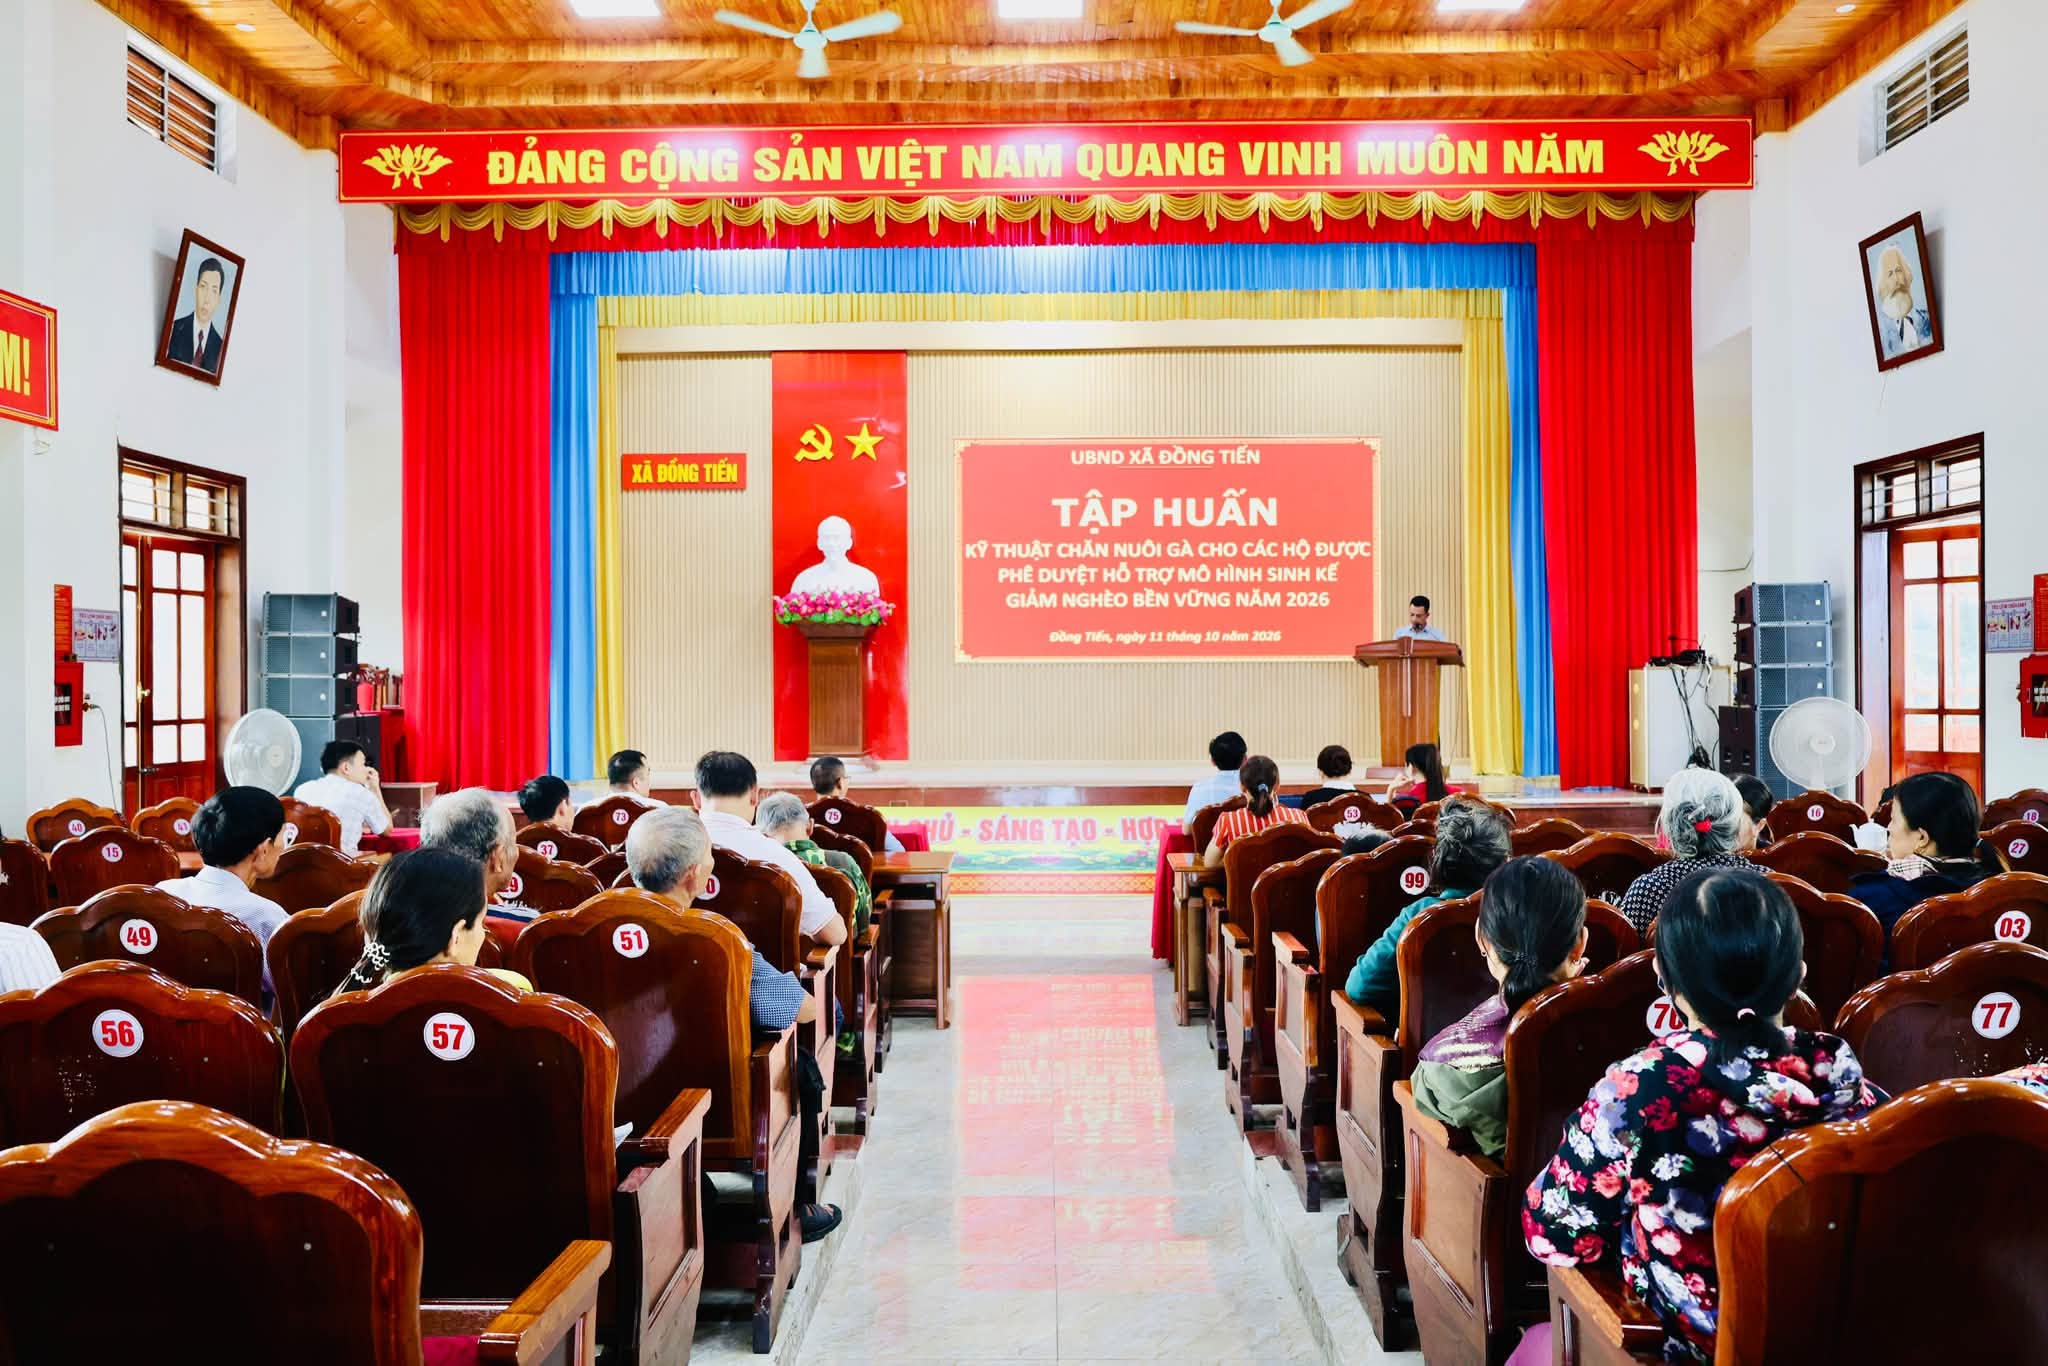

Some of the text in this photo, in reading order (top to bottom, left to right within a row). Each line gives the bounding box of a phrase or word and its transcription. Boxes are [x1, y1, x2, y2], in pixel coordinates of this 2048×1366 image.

[486, 132, 1605, 189] ĐẢNG CỘNG SẢN VIỆT NAM QUANG VINH MUÔN NĂM
[1071, 444, 1261, 465] UBND XÃ ĐỒNG TIẾN
[632, 460, 653, 483] XÃ
[703, 457, 738, 483] TIẾN
[1051, 488, 1278, 534] TẬP HUẤN
[965, 538, 1371, 561] KỸ THUẬT CHĂN NUÔI GÀ CHO CÁC HỘ ĐƯỢC
[998, 561, 1340, 586] PHÊ DUYỆT HỖ TRỢ MÔ HÌNH SINH KẾ
[1006, 587, 1331, 608] GIẢM NGHÈO BỀN VỮNG NĂM 2026
[1049, 630, 1282, 645] Đồng Tiến, ngày 11 tháng 10 năm 2026
[615, 811, 627, 822] 73
[827, 811, 840, 822] 75
[1347, 808, 1359, 819] 53
[2026, 811, 2038, 822] 18
[978, 814, 1044, 842] SÁNG
[1054, 818, 1097, 848] TẠO
[106, 847, 119, 858] 15
[540, 844, 554, 856] 37
[2010, 842, 2027, 854] 27
[1405, 872, 1425, 888] 99
[127, 926, 152, 947] 49
[1999, 917, 2026, 939] 03
[620, 929, 644, 951] 51
[1981, 1002, 2014, 1030] 77
[100, 1019, 136, 1048] 56
[432, 1022, 466, 1051] 57
